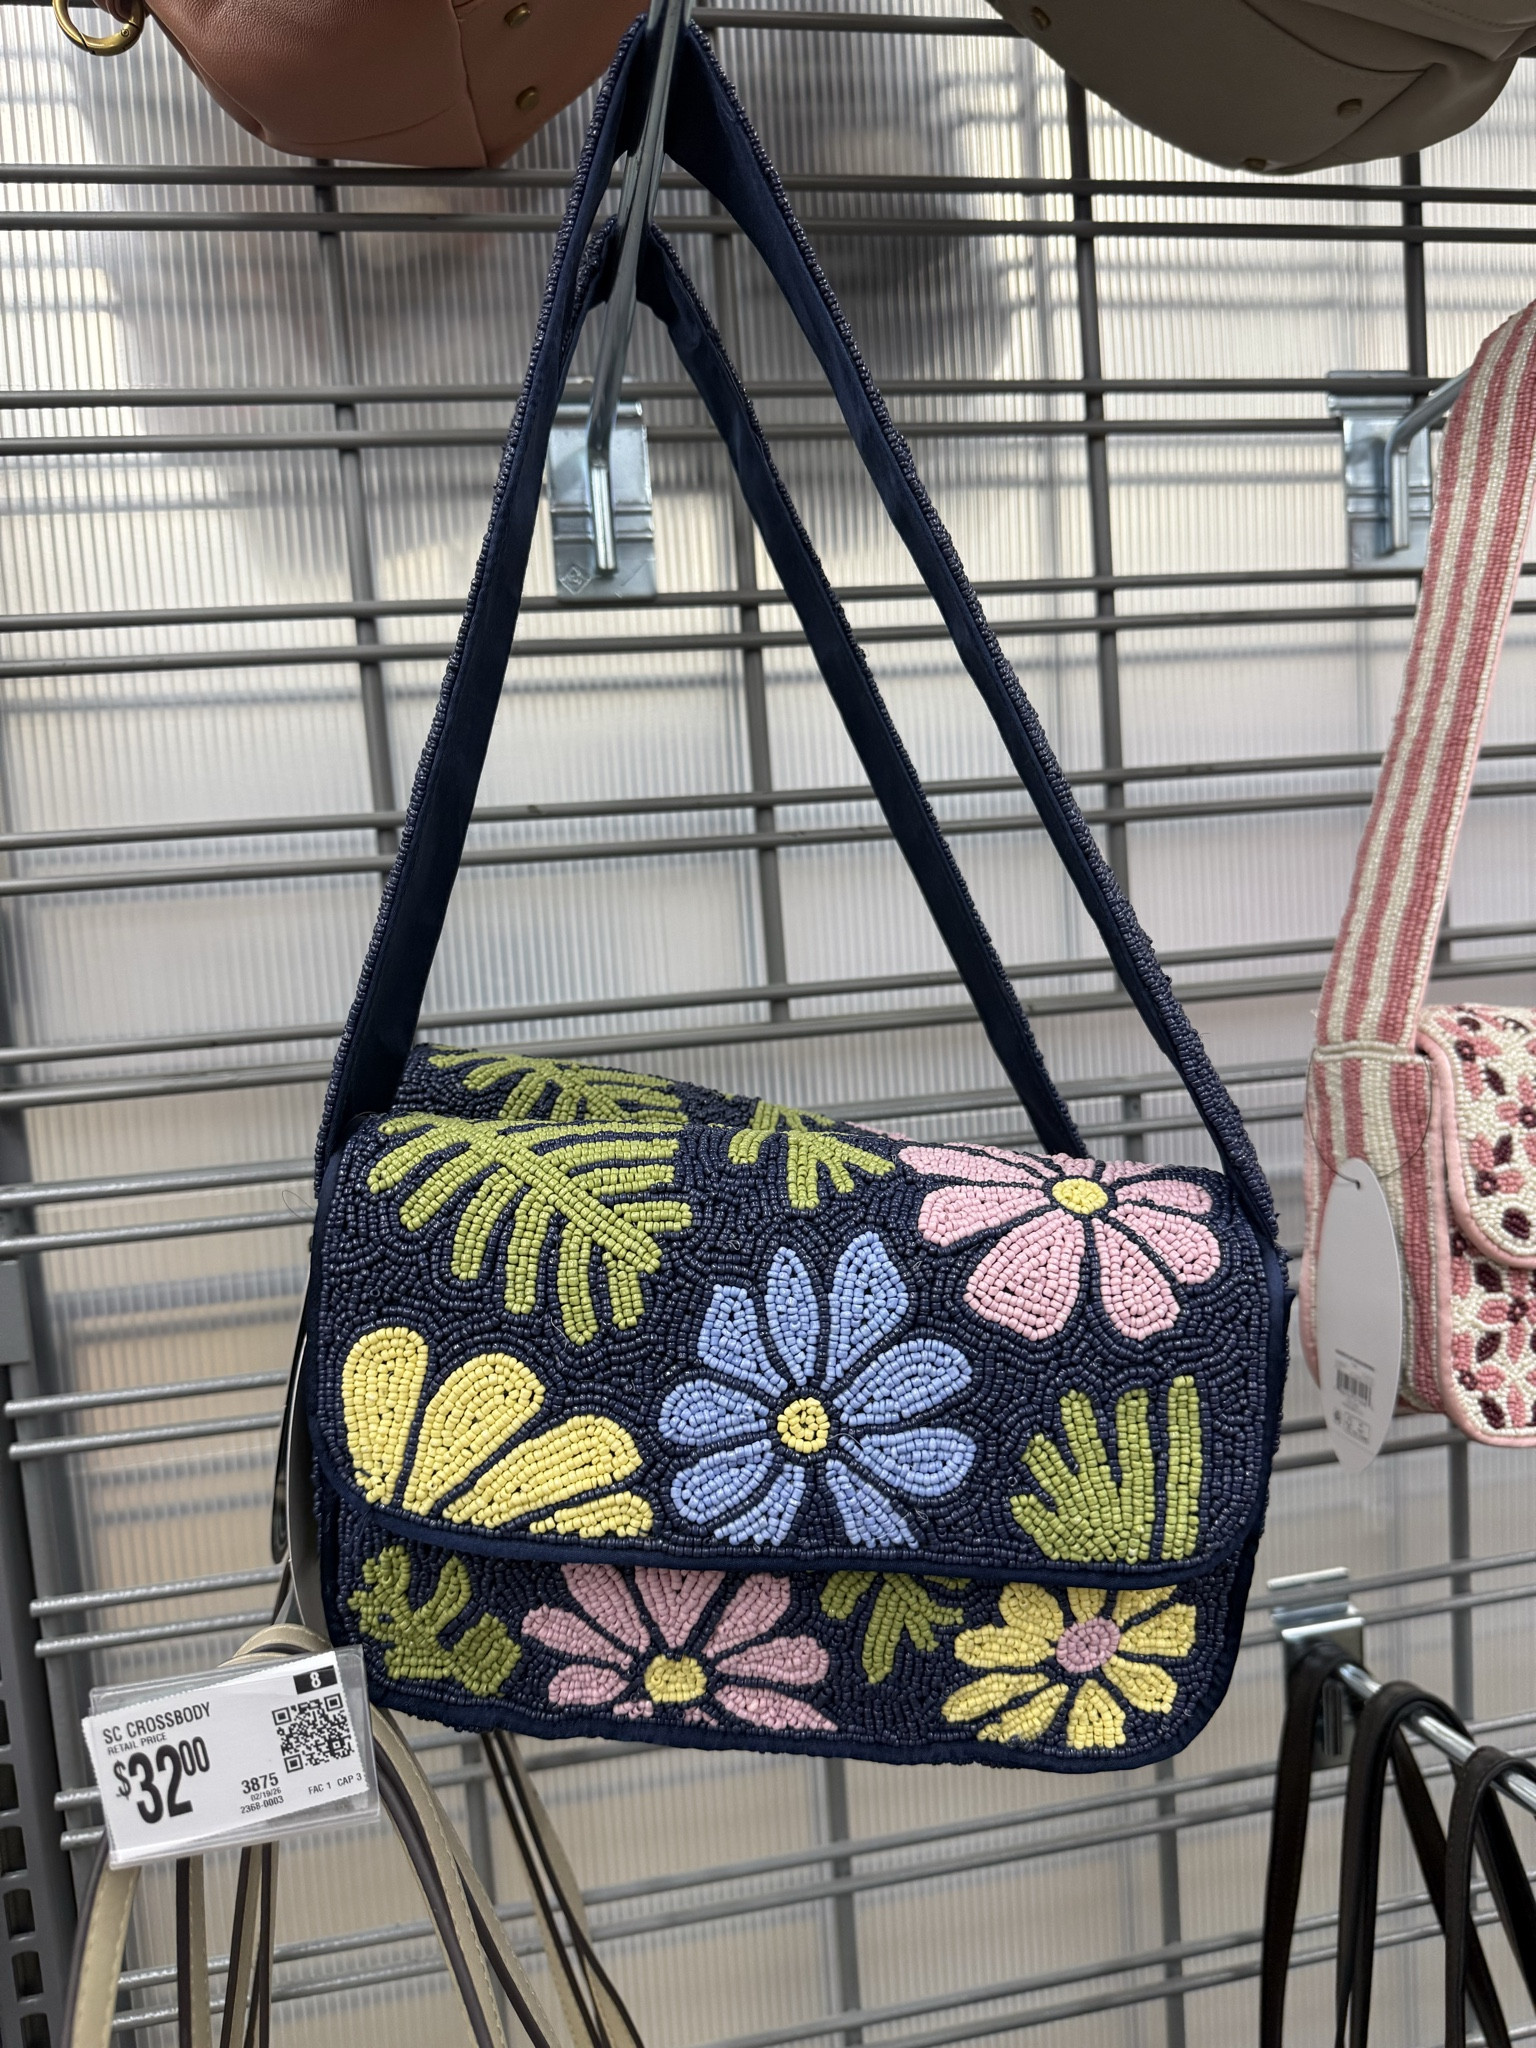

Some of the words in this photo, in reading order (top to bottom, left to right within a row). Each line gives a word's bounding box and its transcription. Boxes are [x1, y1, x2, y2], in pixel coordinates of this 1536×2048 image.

[309, 1671, 322, 1688] 8
[102, 1725, 123, 1744] SC
[126, 1701, 210, 1738] CROSSBODY
[107, 1741, 138, 1755] RETAIL
[140, 1732, 167, 1747] PRICE
[241, 1772, 279, 1794] 3875
[308, 1783, 325, 1795] FAC
[336, 1775, 354, 1787] CAP
[356, 1772, 362, 1781] 3
[240, 1796, 284, 1814] 2368-0003
